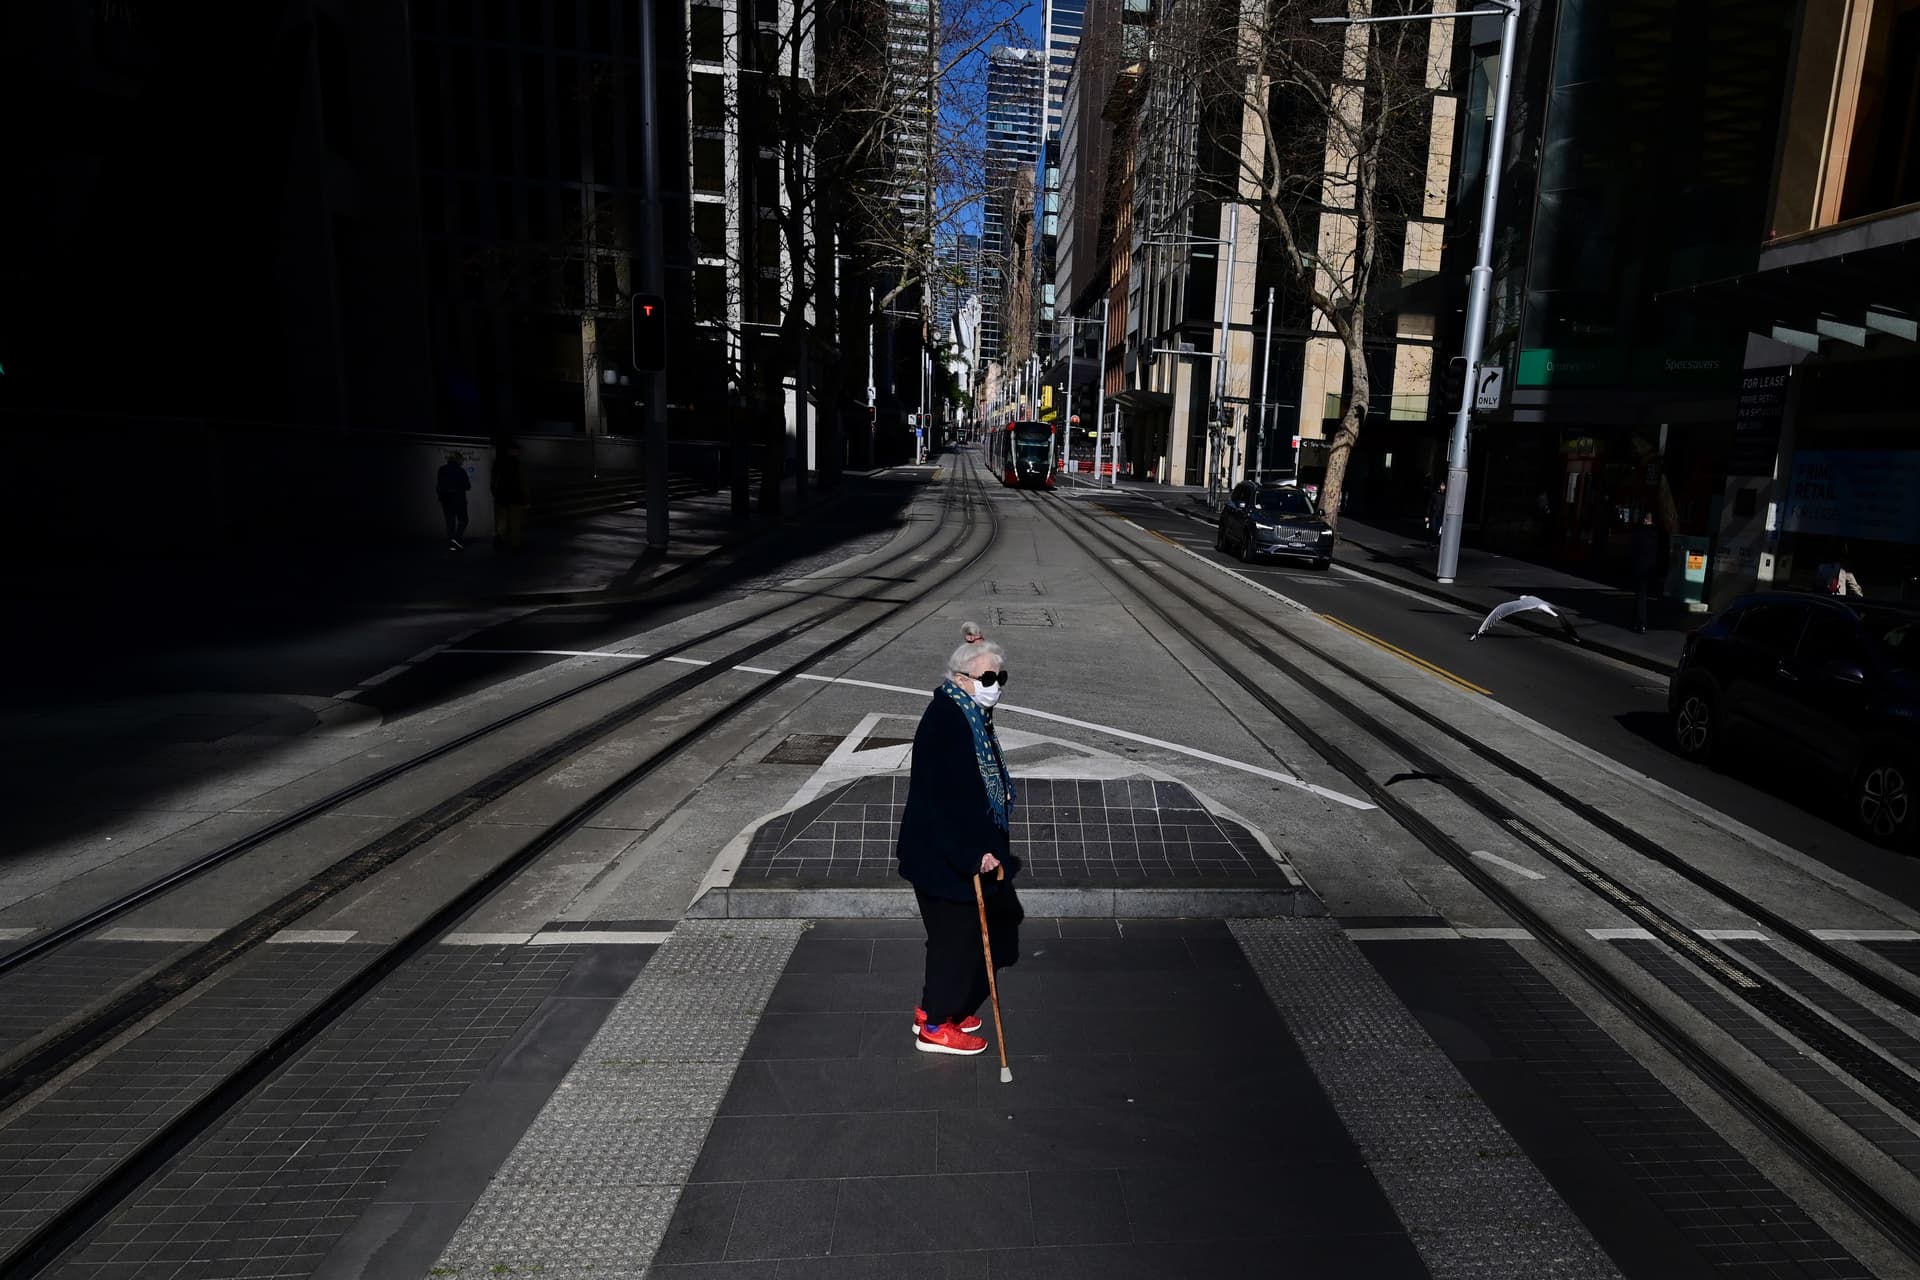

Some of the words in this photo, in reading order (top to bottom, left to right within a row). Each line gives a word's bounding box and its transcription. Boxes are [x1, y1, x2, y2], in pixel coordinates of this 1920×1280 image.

[1663, 358, 1720, 372] Specsavers
[1743, 378, 1758, 389] FOR
[1759, 375, 1785, 388] LEASE
[1478, 397, 1498, 405] ONLY
